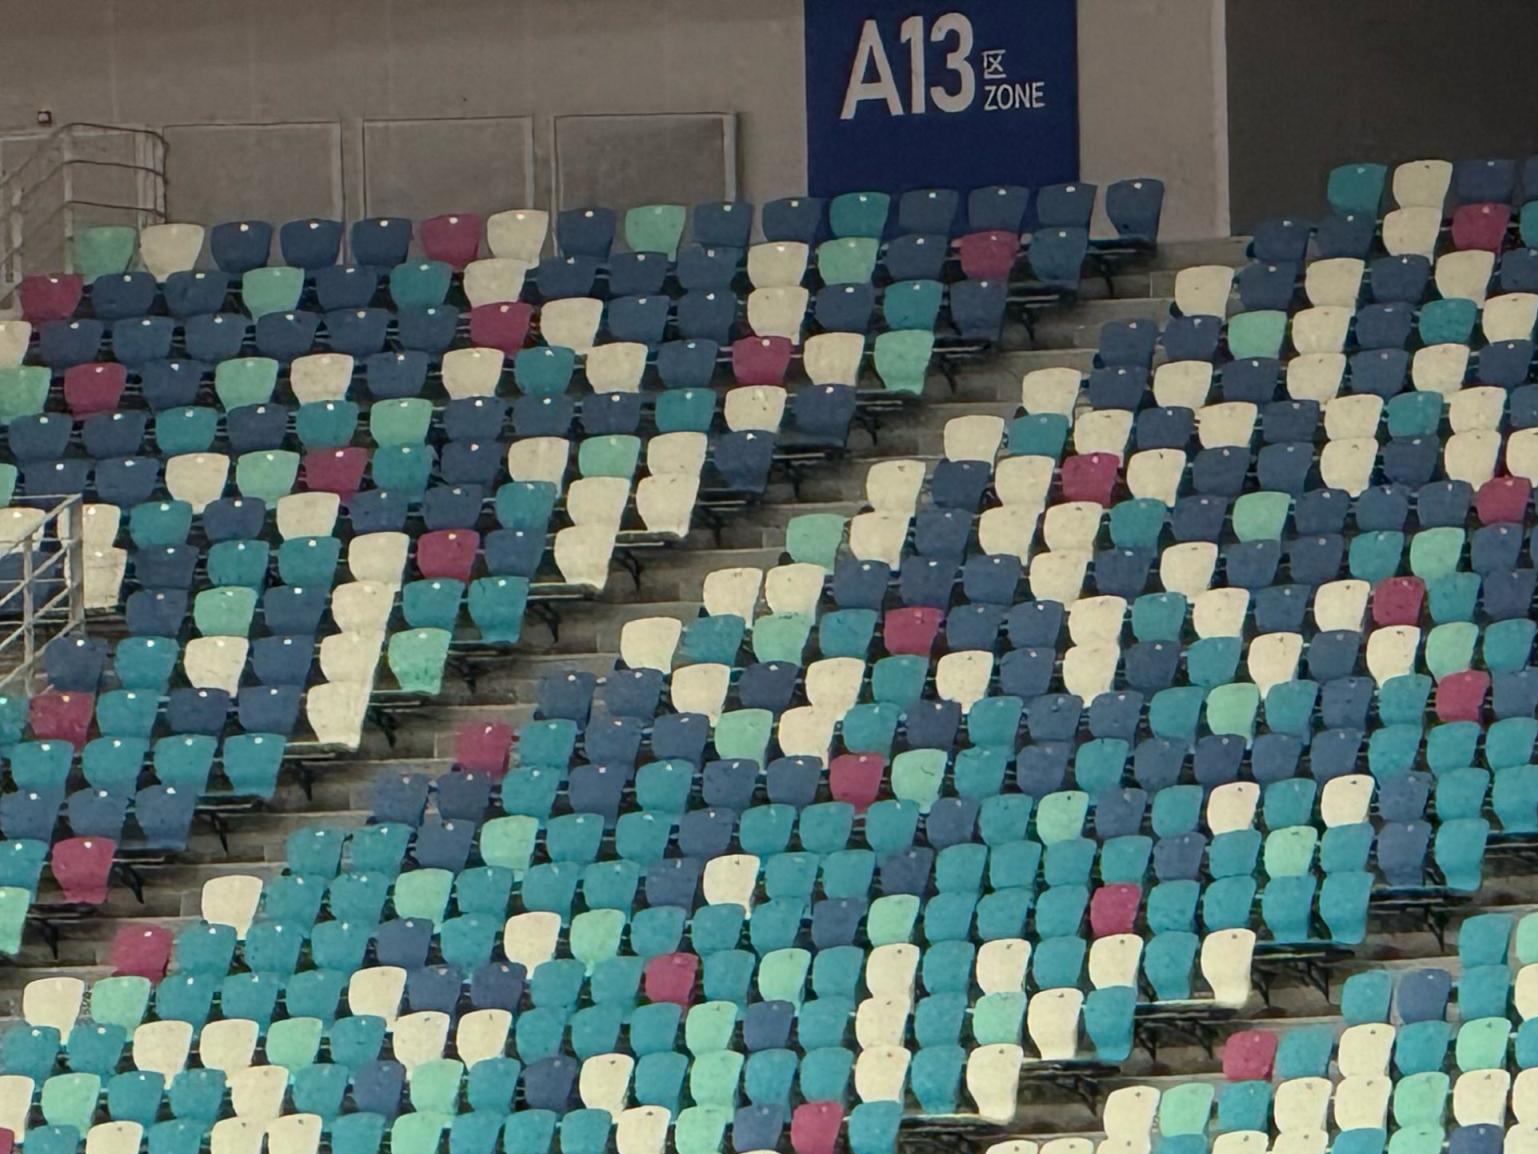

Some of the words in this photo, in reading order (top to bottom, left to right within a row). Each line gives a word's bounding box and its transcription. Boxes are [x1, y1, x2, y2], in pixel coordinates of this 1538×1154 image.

[840, 12, 976, 119] A13
[982, 49, 1006, 79] 区
[984, 81, 1045, 111] ZONE
